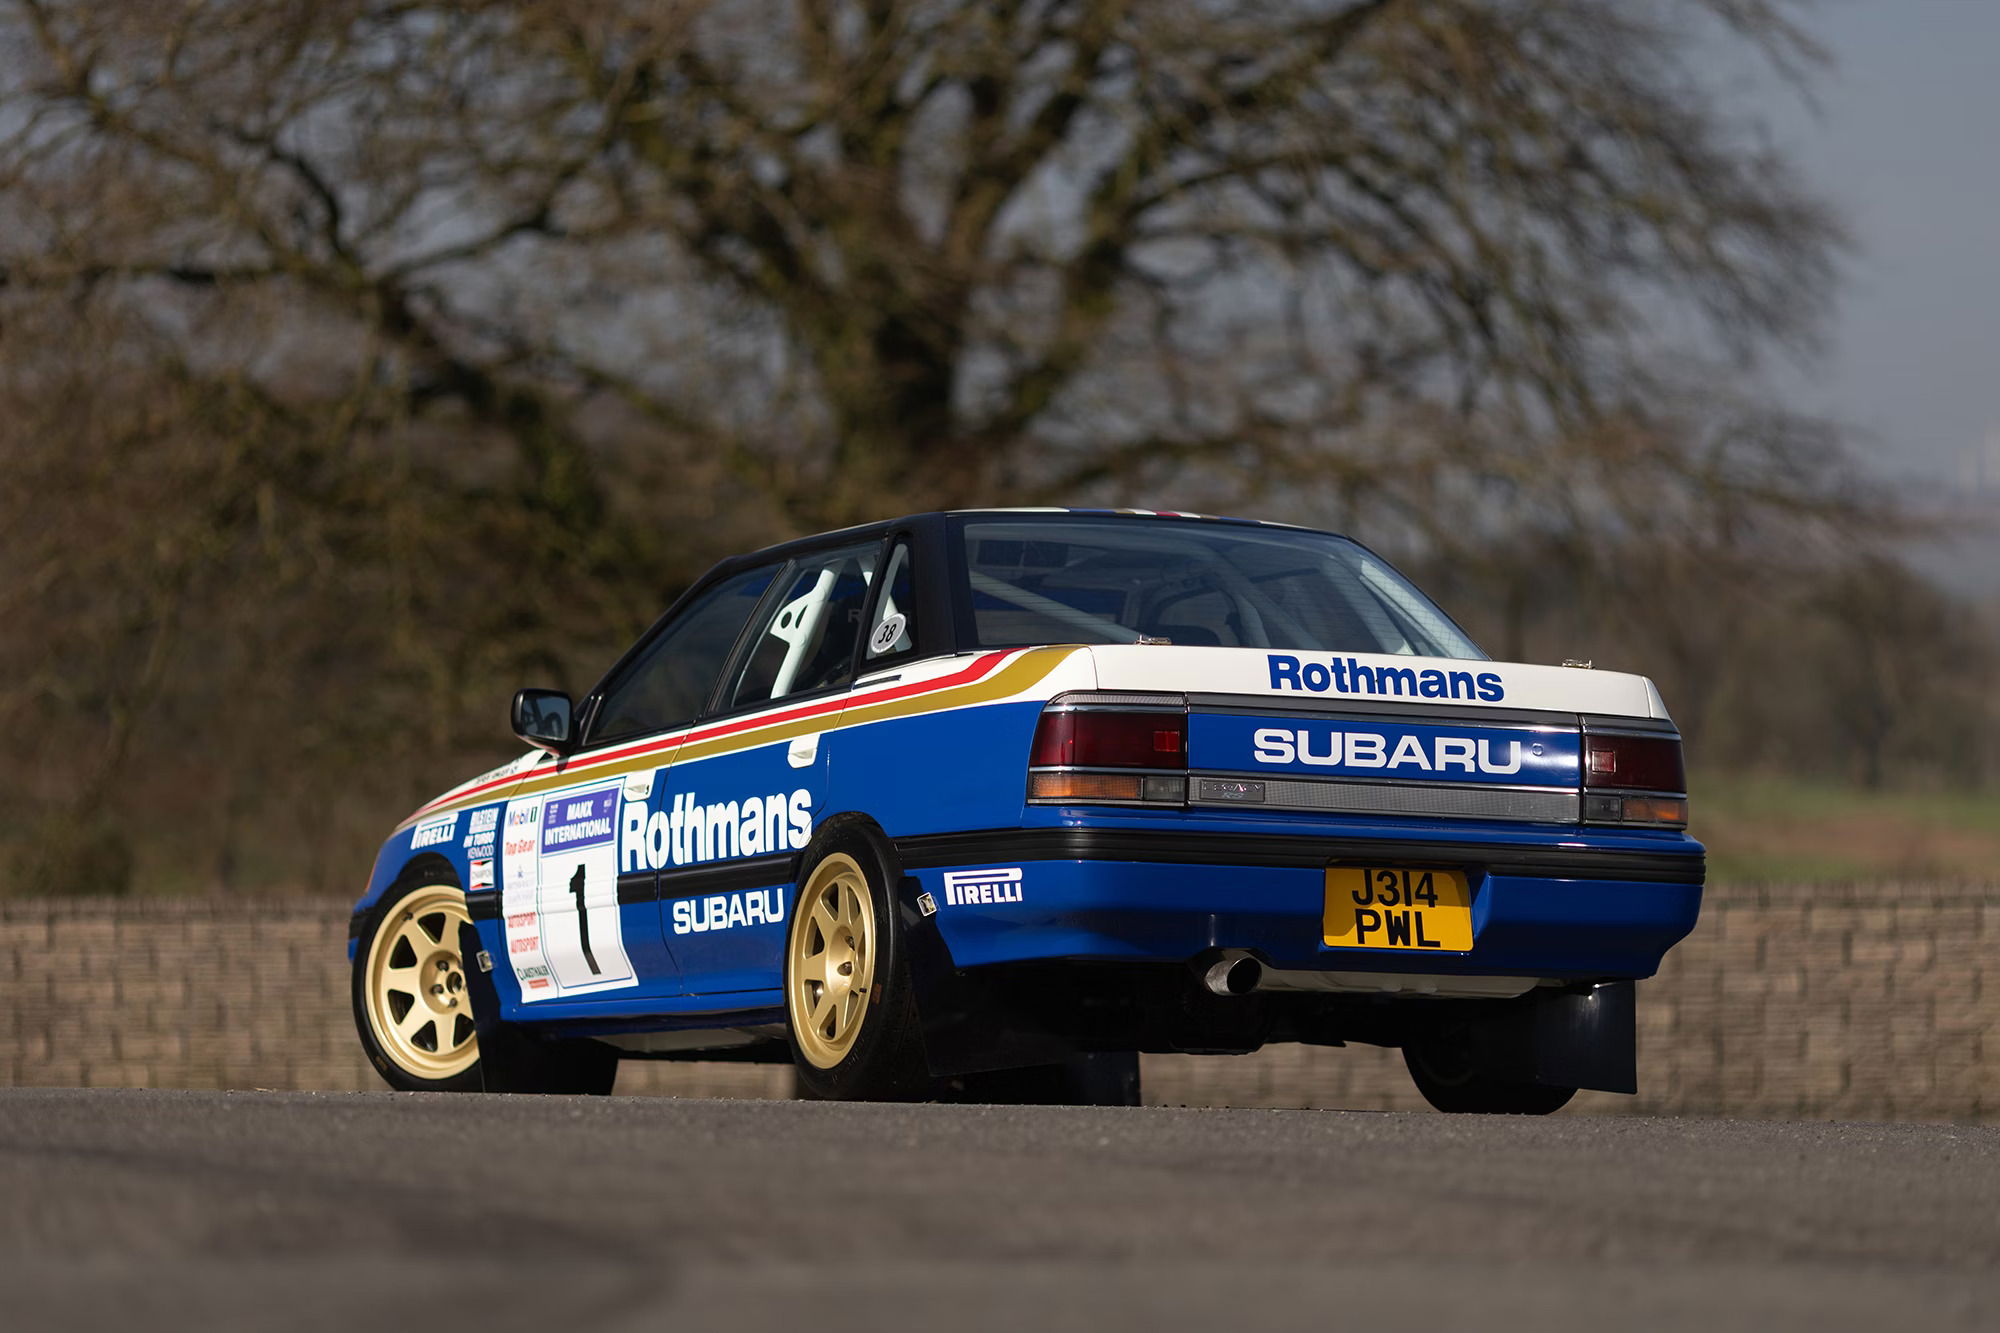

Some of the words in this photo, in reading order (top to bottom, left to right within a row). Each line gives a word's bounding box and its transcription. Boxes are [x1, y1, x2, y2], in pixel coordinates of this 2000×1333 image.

[877, 623, 897, 644] 38
[1267, 654, 1506, 702] Rothmans
[1253, 728, 1522, 776] SUBARU
[410, 811, 460, 850] PIRELLI
[508, 807, 529, 825] Mobil
[566, 800, 594, 822] MANX
[621, 788, 813, 873] Rothmans
[505, 842, 518, 857] Top
[518, 840, 536, 855] Gear
[544, 817, 612, 847] INTERNATIONAL
[943, 867, 1024, 906] PIRELLI
[1351, 869, 1438, 908] J314
[507, 911, 536, 928] AUTOSPORT
[569, 863, 602, 975] 1
[672, 888, 785, 935] SUBARU
[1355, 908, 1441, 948] PWL
[510, 936, 539, 953] AUTOSPORT
